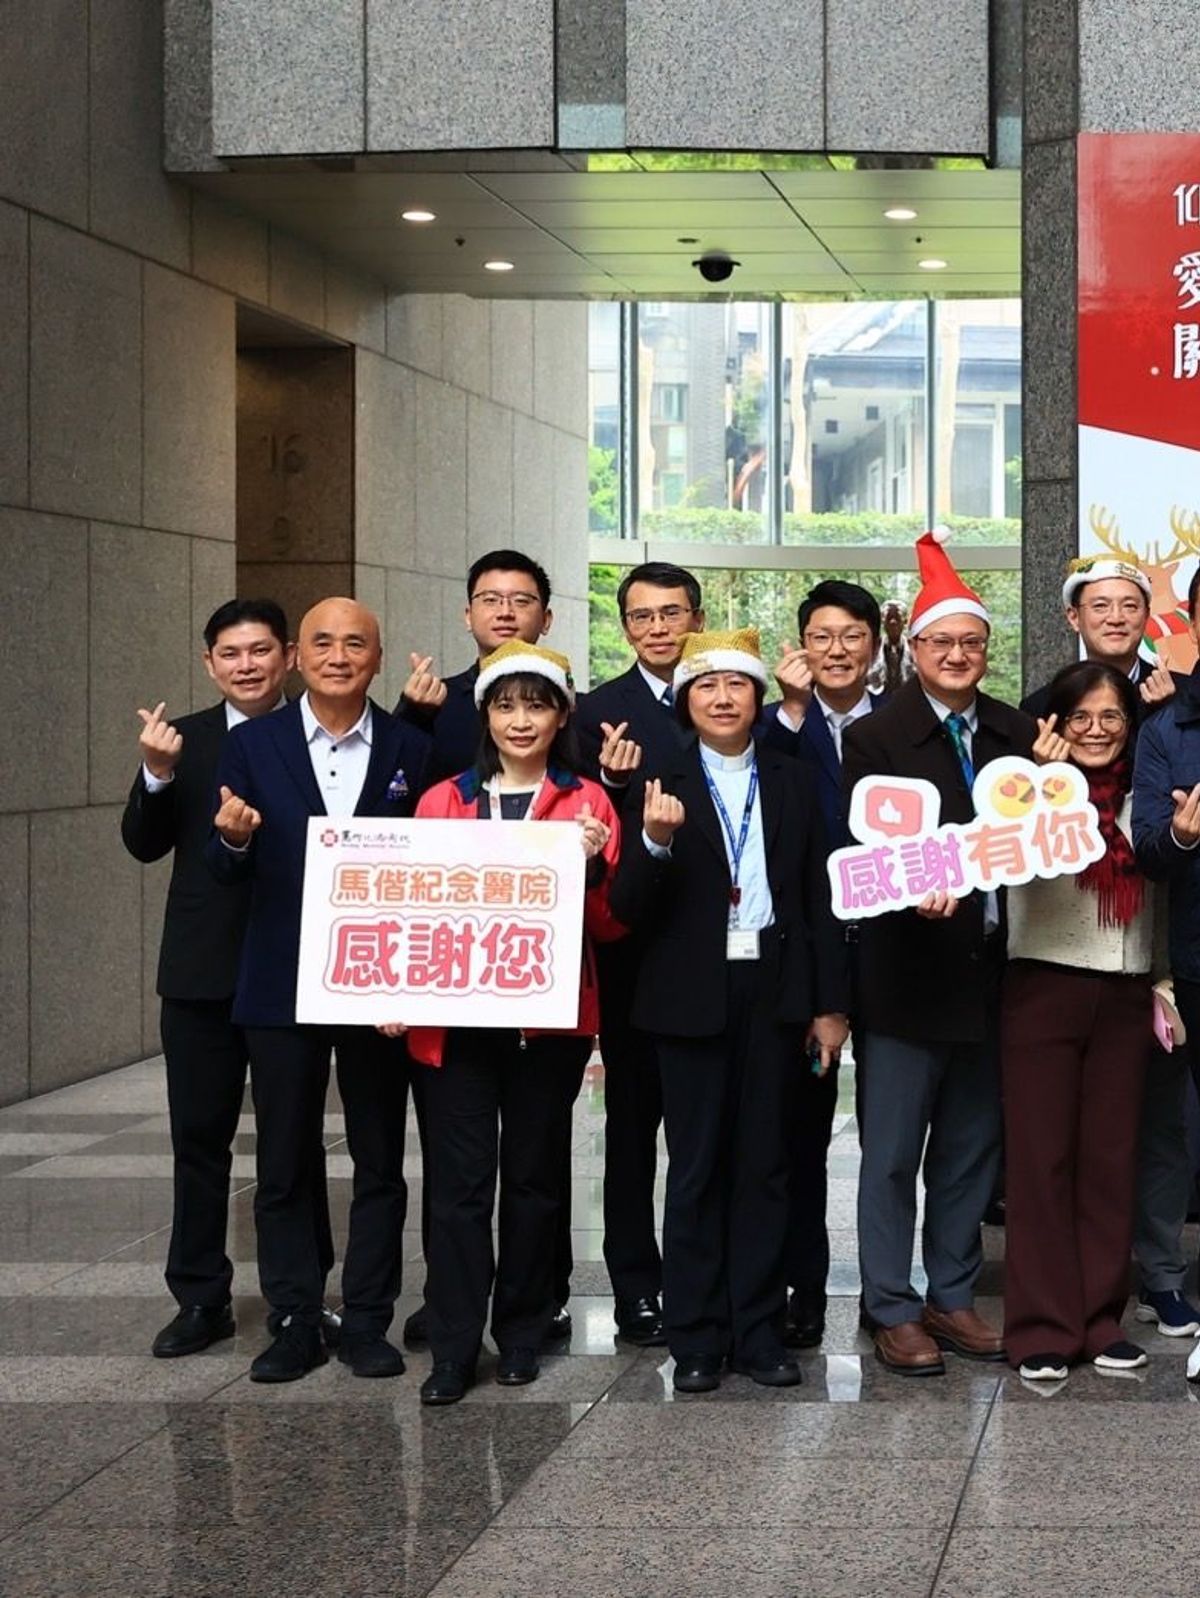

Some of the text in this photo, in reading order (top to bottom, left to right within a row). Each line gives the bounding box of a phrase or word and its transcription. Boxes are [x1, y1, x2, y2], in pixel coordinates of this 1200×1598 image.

[336, 868, 552, 905] 馬偕紀念醫院
[838, 811, 1095, 908] 感謝有你
[331, 921, 546, 989] 感謝您
